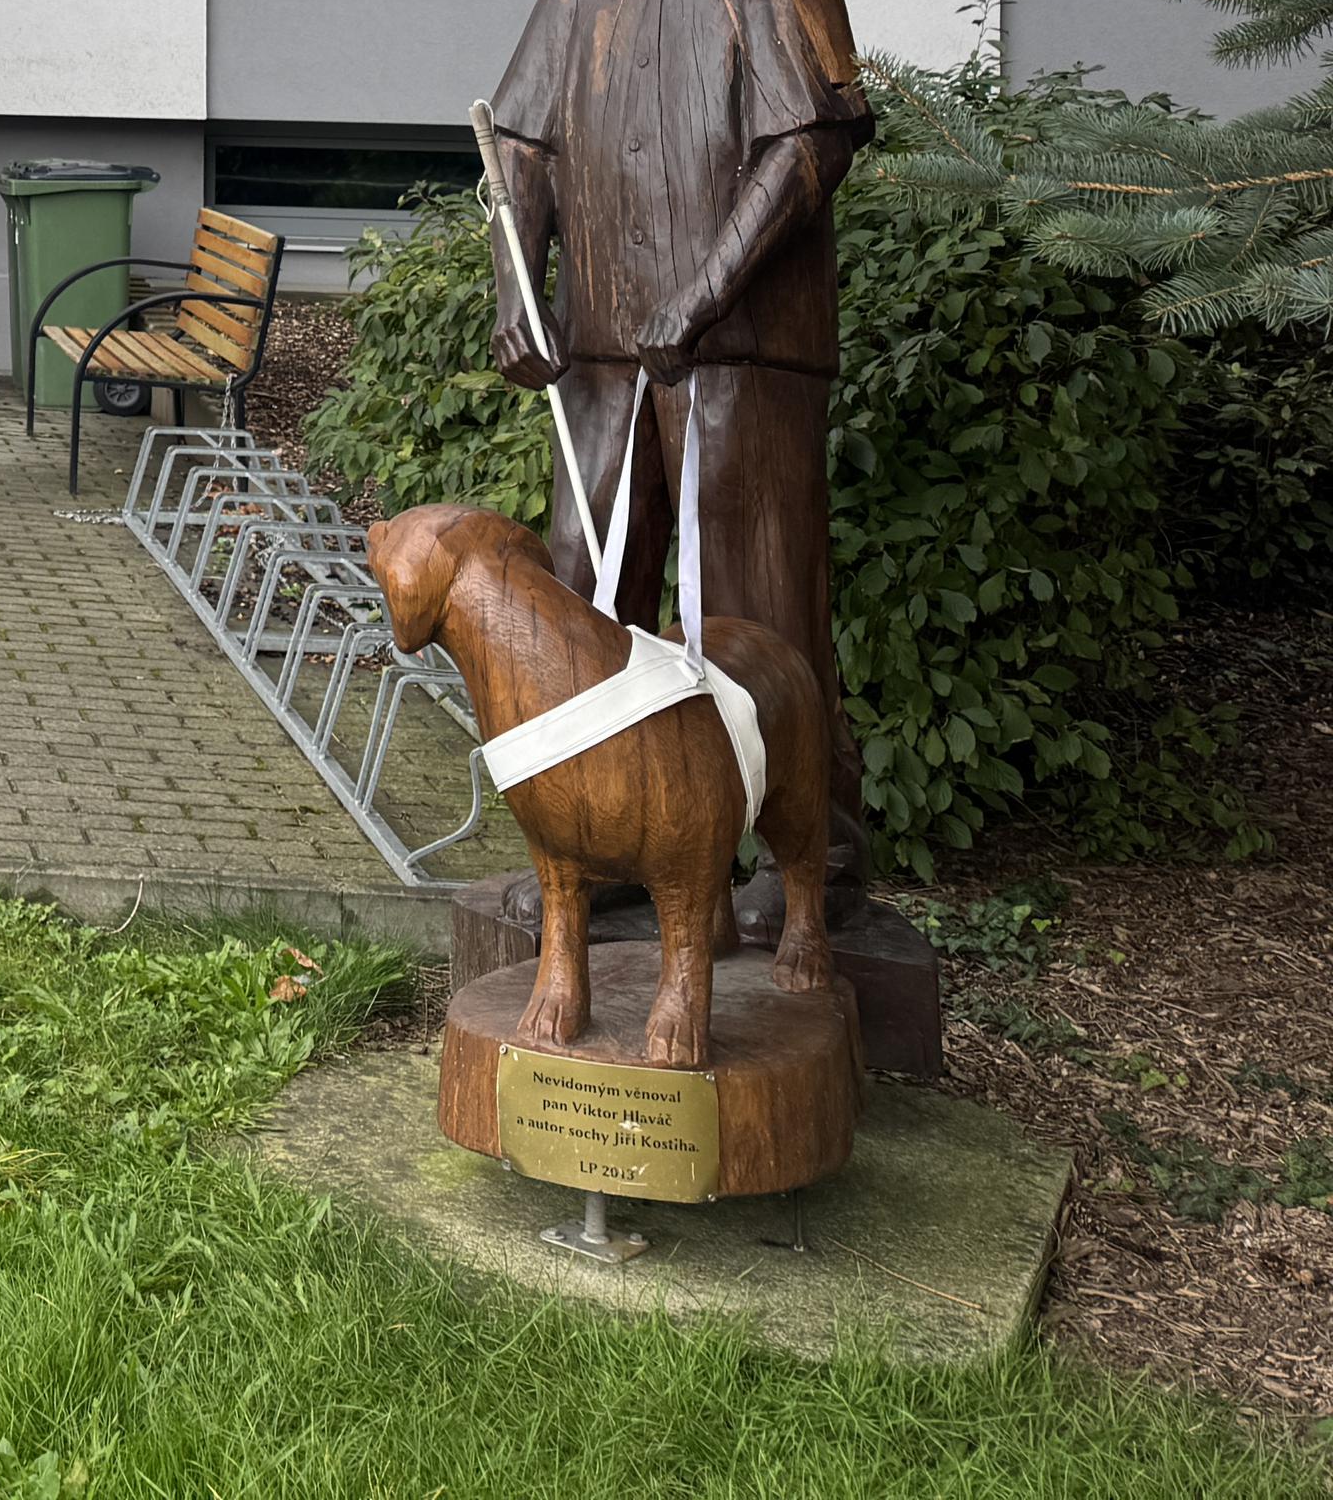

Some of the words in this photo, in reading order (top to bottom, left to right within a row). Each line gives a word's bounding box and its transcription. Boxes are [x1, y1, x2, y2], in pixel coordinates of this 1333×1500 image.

[532, 1070, 621, 1098] Nevidomým
[624, 1085, 681, 1104] věnoval
[542, 1099, 568, 1113] pan
[572, 1102, 618, 1120] Viktor
[622, 1109, 673, 1127] Hlaváč
[516, 1115, 525, 1126] a
[527, 1119, 565, 1135] autor
[568, 1127, 610, 1146] sochy
[612, 1131, 637, 1148] Jiří
[640, 1136, 700, 1153] Kostiha.
[579, 1161, 598, 1175] LP
